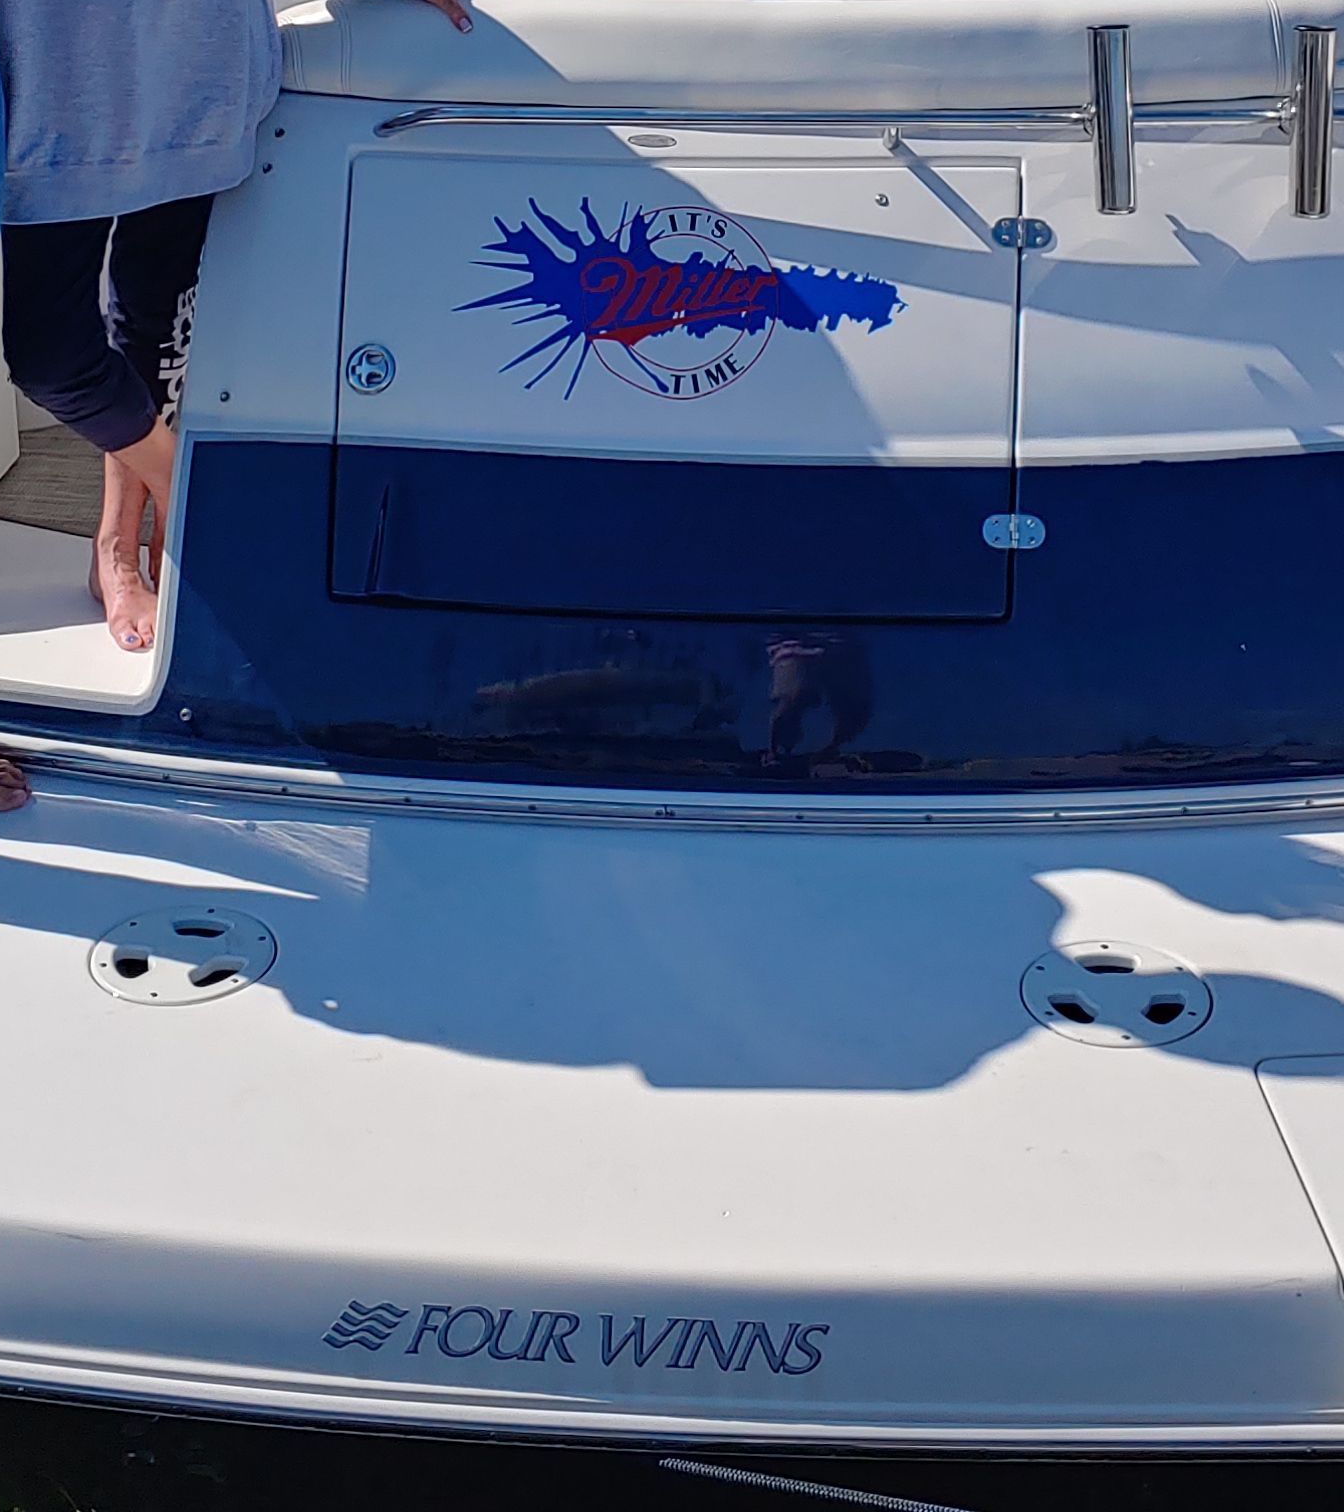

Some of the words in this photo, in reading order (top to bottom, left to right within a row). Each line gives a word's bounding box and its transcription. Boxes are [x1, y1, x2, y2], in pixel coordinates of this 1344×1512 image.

[668, 212, 728, 238] IT'S
[580, 257, 778, 326] Miller
[671, 353, 745, 394] TIME
[405, 1304, 580, 1363] FOUR
[599, 1314, 830, 1375] WINNS
